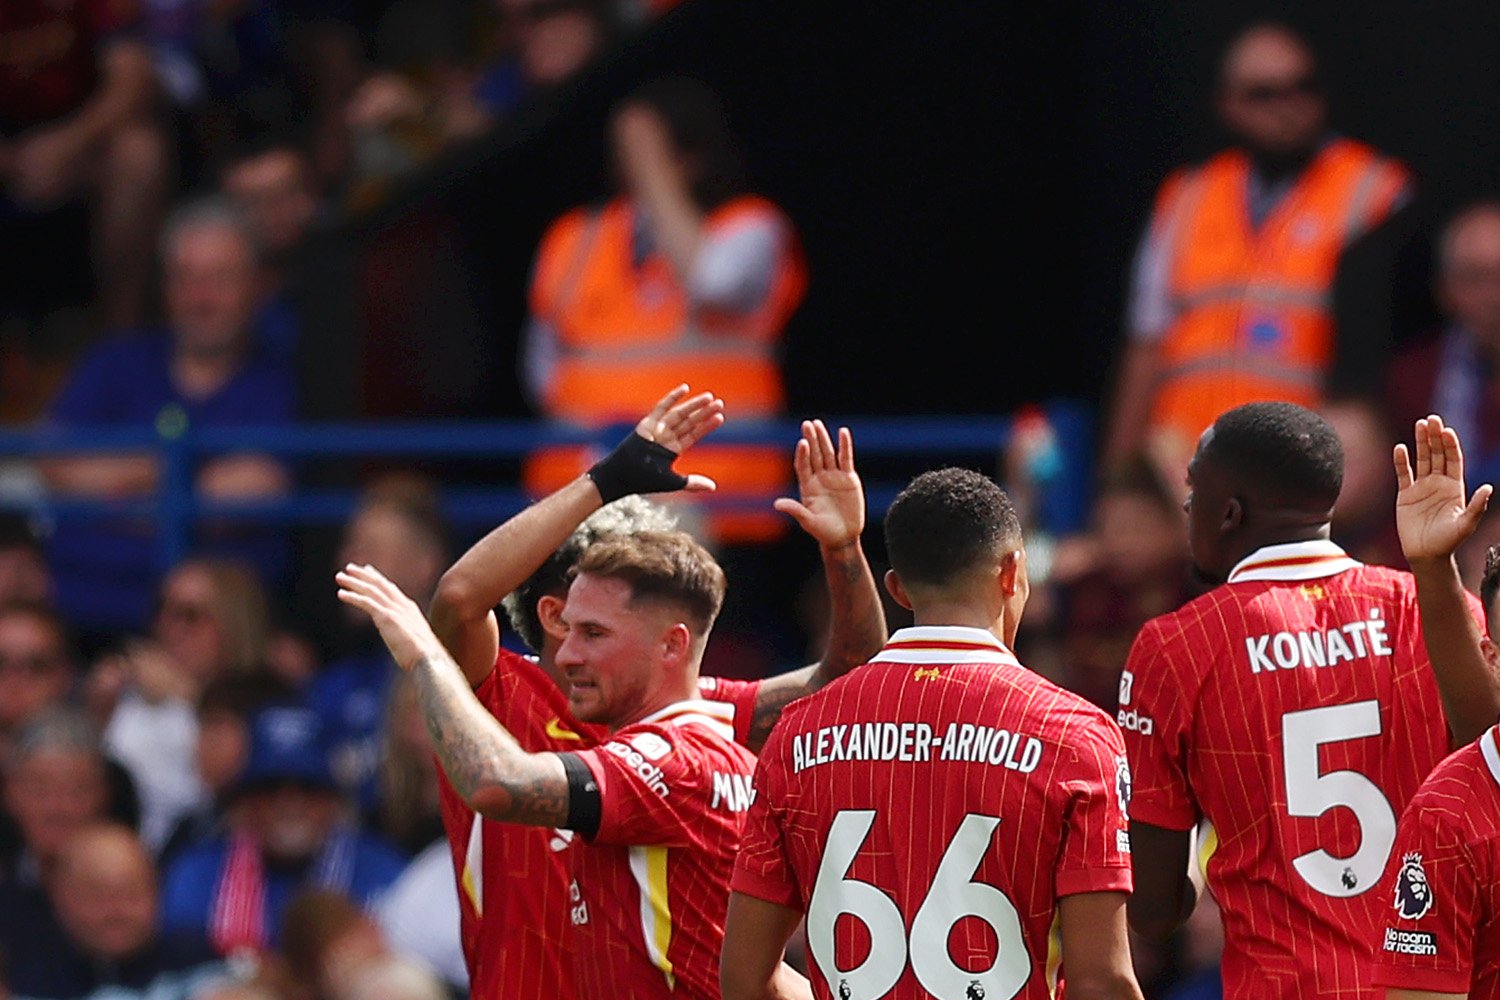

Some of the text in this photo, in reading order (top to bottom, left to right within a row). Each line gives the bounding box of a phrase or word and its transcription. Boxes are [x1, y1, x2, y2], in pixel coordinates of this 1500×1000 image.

[1245, 608, 1393, 674] KONATÉ
[792, 722, 1043, 775] ALEXANDER-ARNOLD
[711, 770, 757, 812] MA
[1281, 699, 1398, 898] 5
[1385, 927, 1431, 944] No room
[1396, 941, 1437, 955] racism
